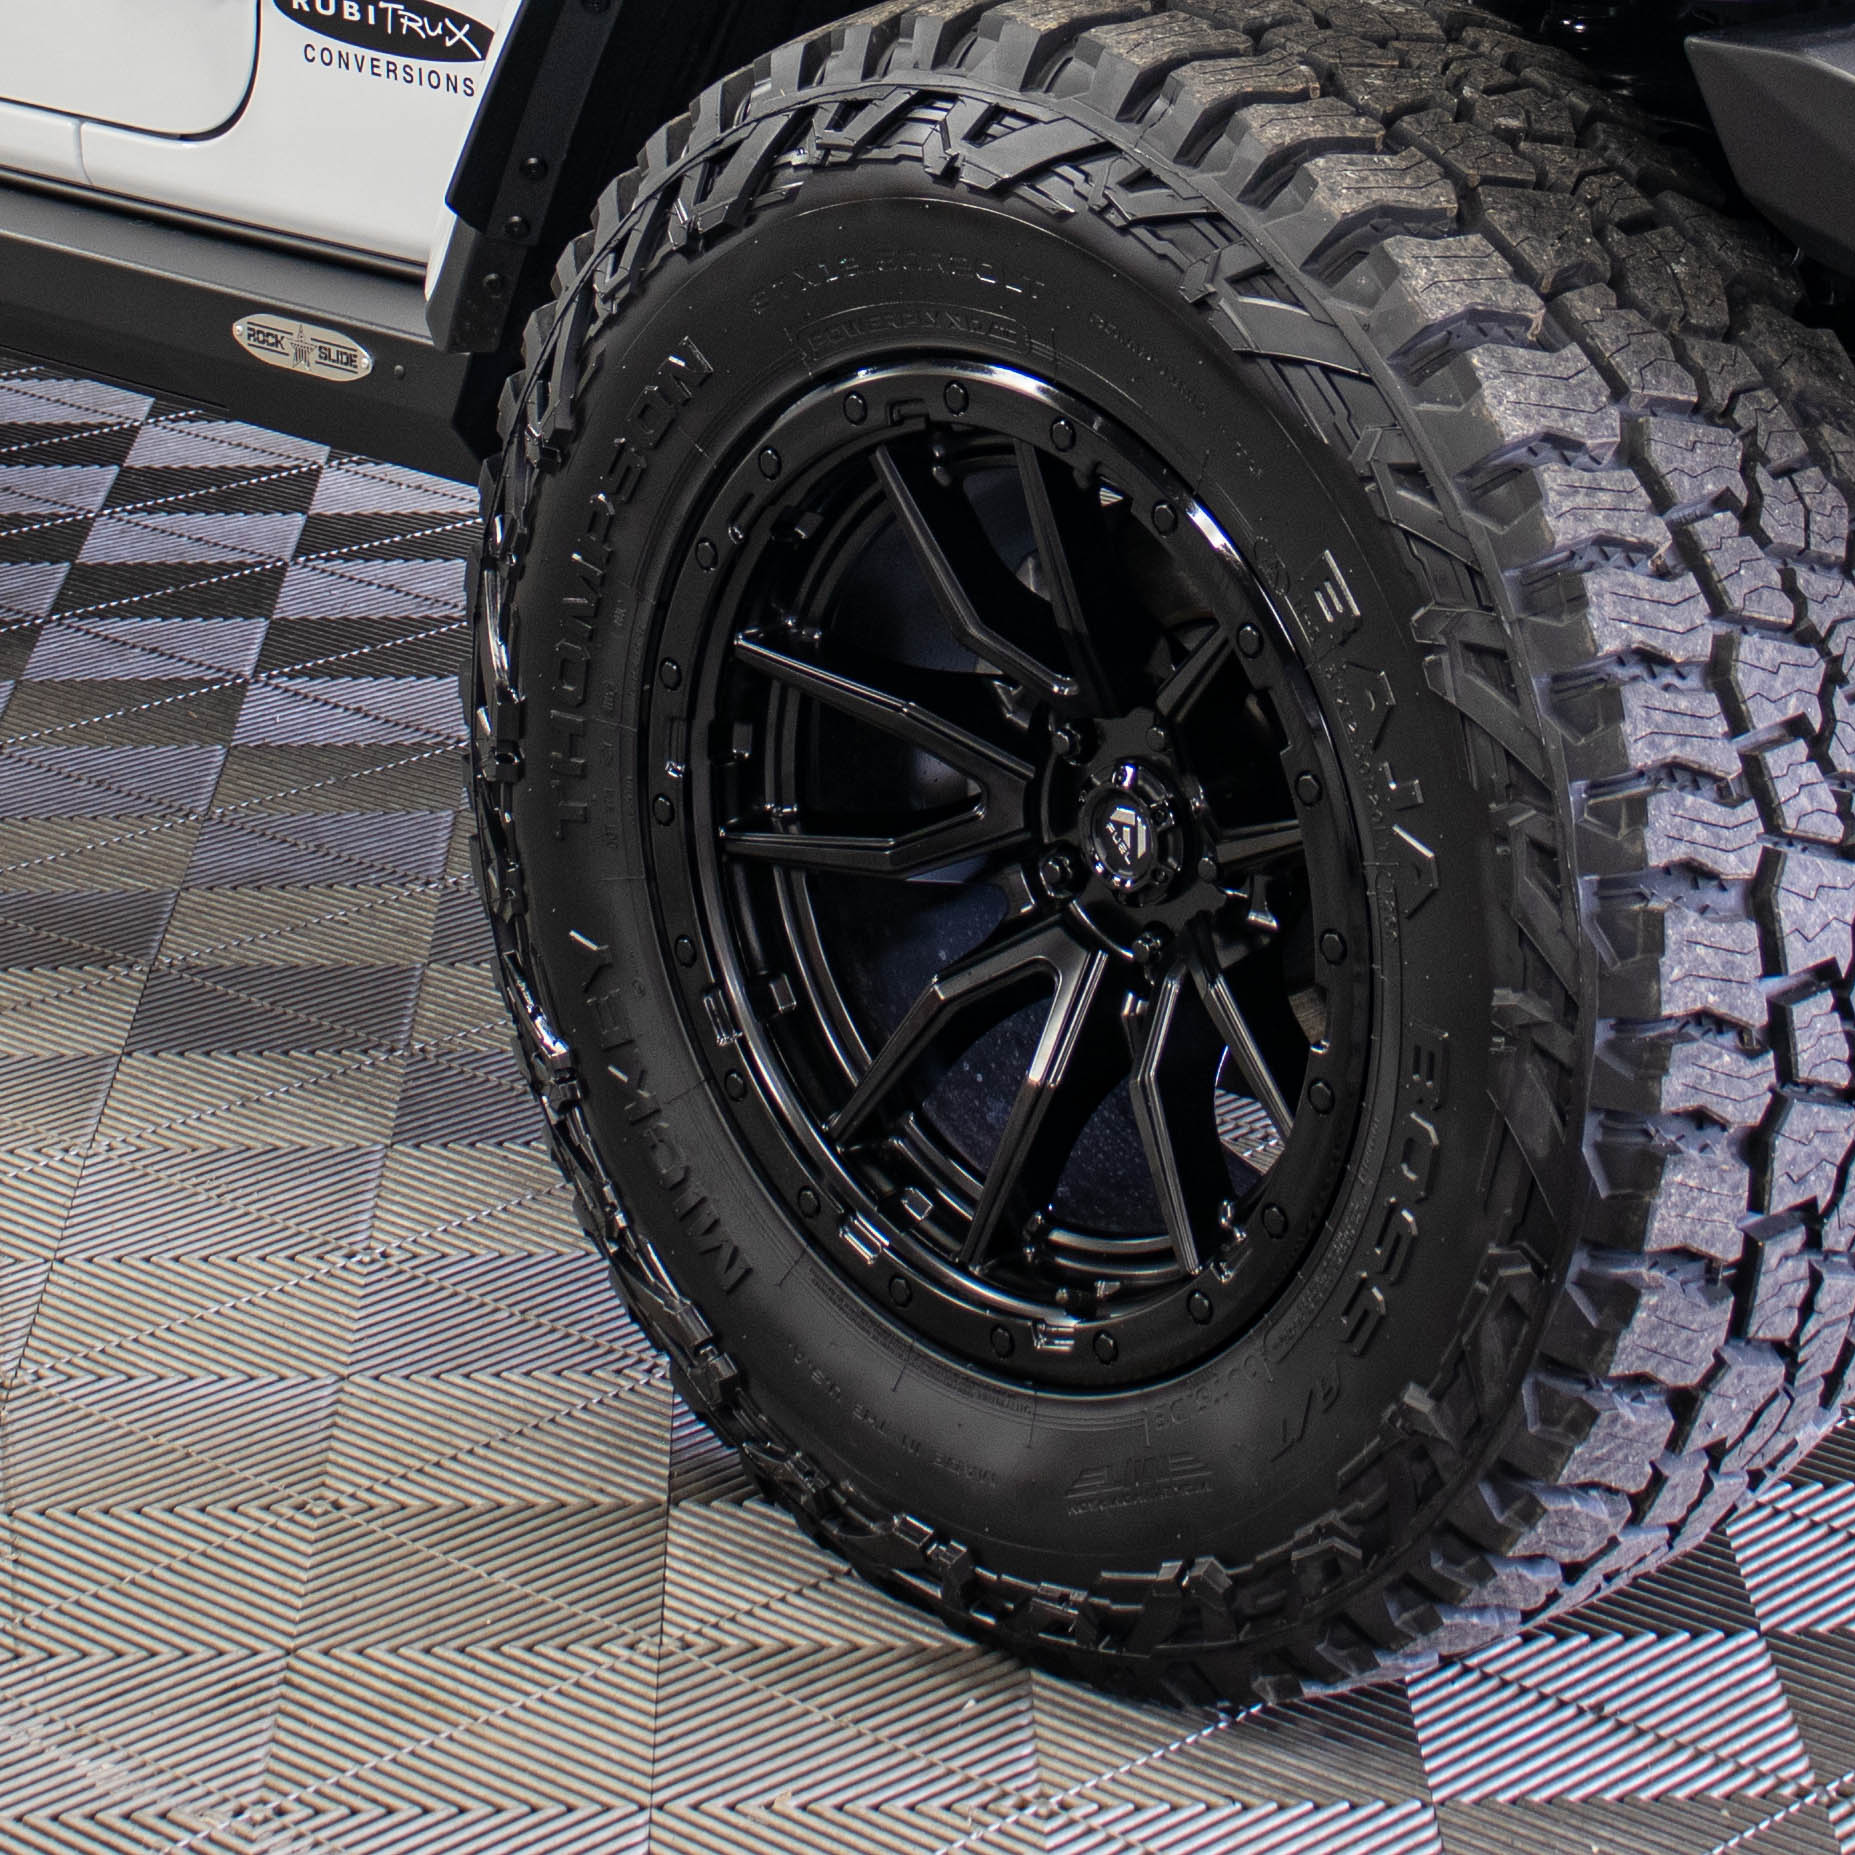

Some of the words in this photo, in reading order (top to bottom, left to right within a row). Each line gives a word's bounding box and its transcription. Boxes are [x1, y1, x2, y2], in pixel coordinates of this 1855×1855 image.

[303, 43, 476, 98] CONVERSIONS
[246, 326, 286, 351] ROCK
[317, 345, 359, 370] SLIDE
[1104, 822, 1131, 866] FUEL
